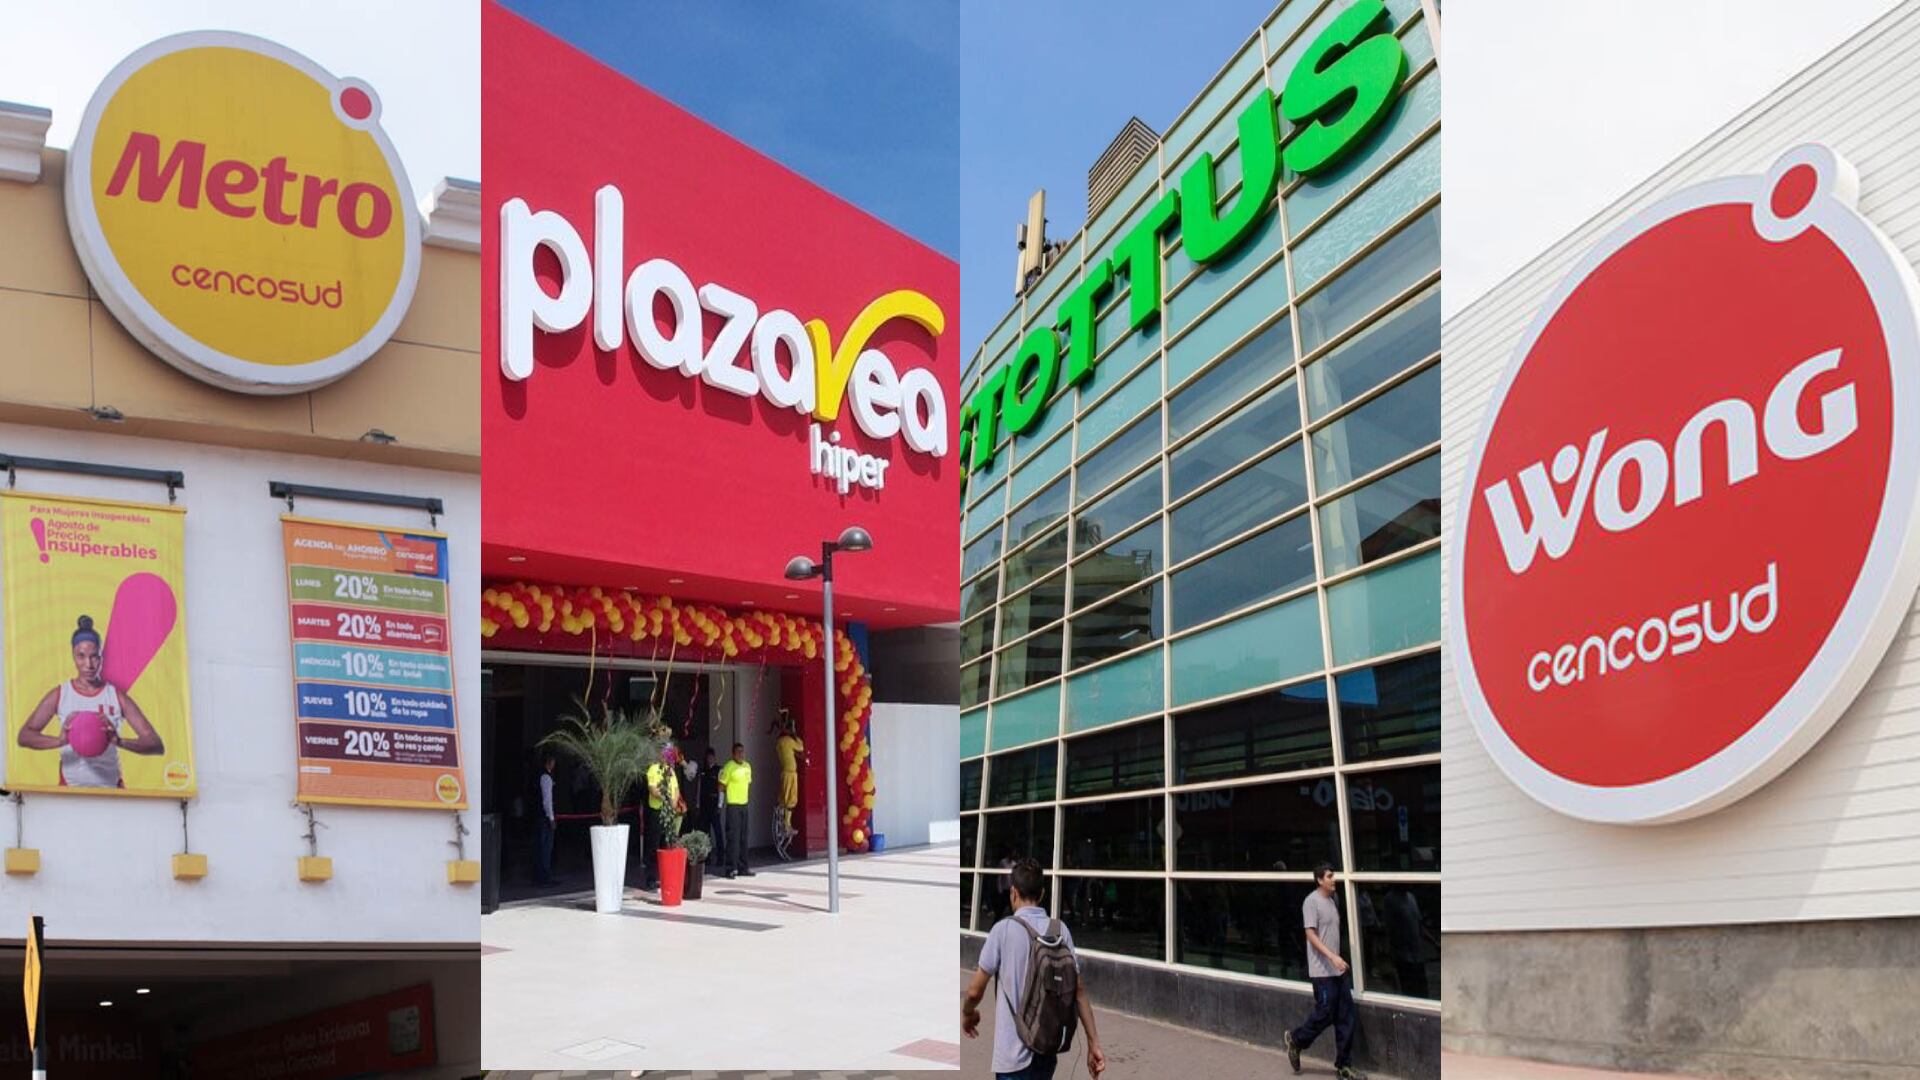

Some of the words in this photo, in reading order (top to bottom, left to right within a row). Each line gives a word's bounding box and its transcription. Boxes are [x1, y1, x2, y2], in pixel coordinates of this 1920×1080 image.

[105, 131, 392, 239] Metro
[171, 264, 343, 309] cencosud
[810, 422, 889, 494] hiper
[30, 505, 51, 514] Para
[52, 507, 89, 518] Mujeres
[47, 529, 91, 542] Precios
[48, 518, 84, 530] Agosto
[87, 522, 100, 532] de
[293, 538, 333, 550] AGENDA
[346, 543, 387, 556] AHORRO
[295, 578, 321, 588] LUNES
[334, 574, 378, 599] 20%
[297, 617, 331, 627] MARTES
[336, 612, 382, 638] 20%
[1526, 562, 1778, 692] cencosud
[341, 651, 384, 677] 10%
[302, 696, 333, 706] JUEVES
[344, 690, 387, 716] 10%
[305, 736, 339, 746] VIERNES
[344, 730, 390, 756] 20%
[394, 732, 404, 741] En
[404, 733, 422, 742] todo
